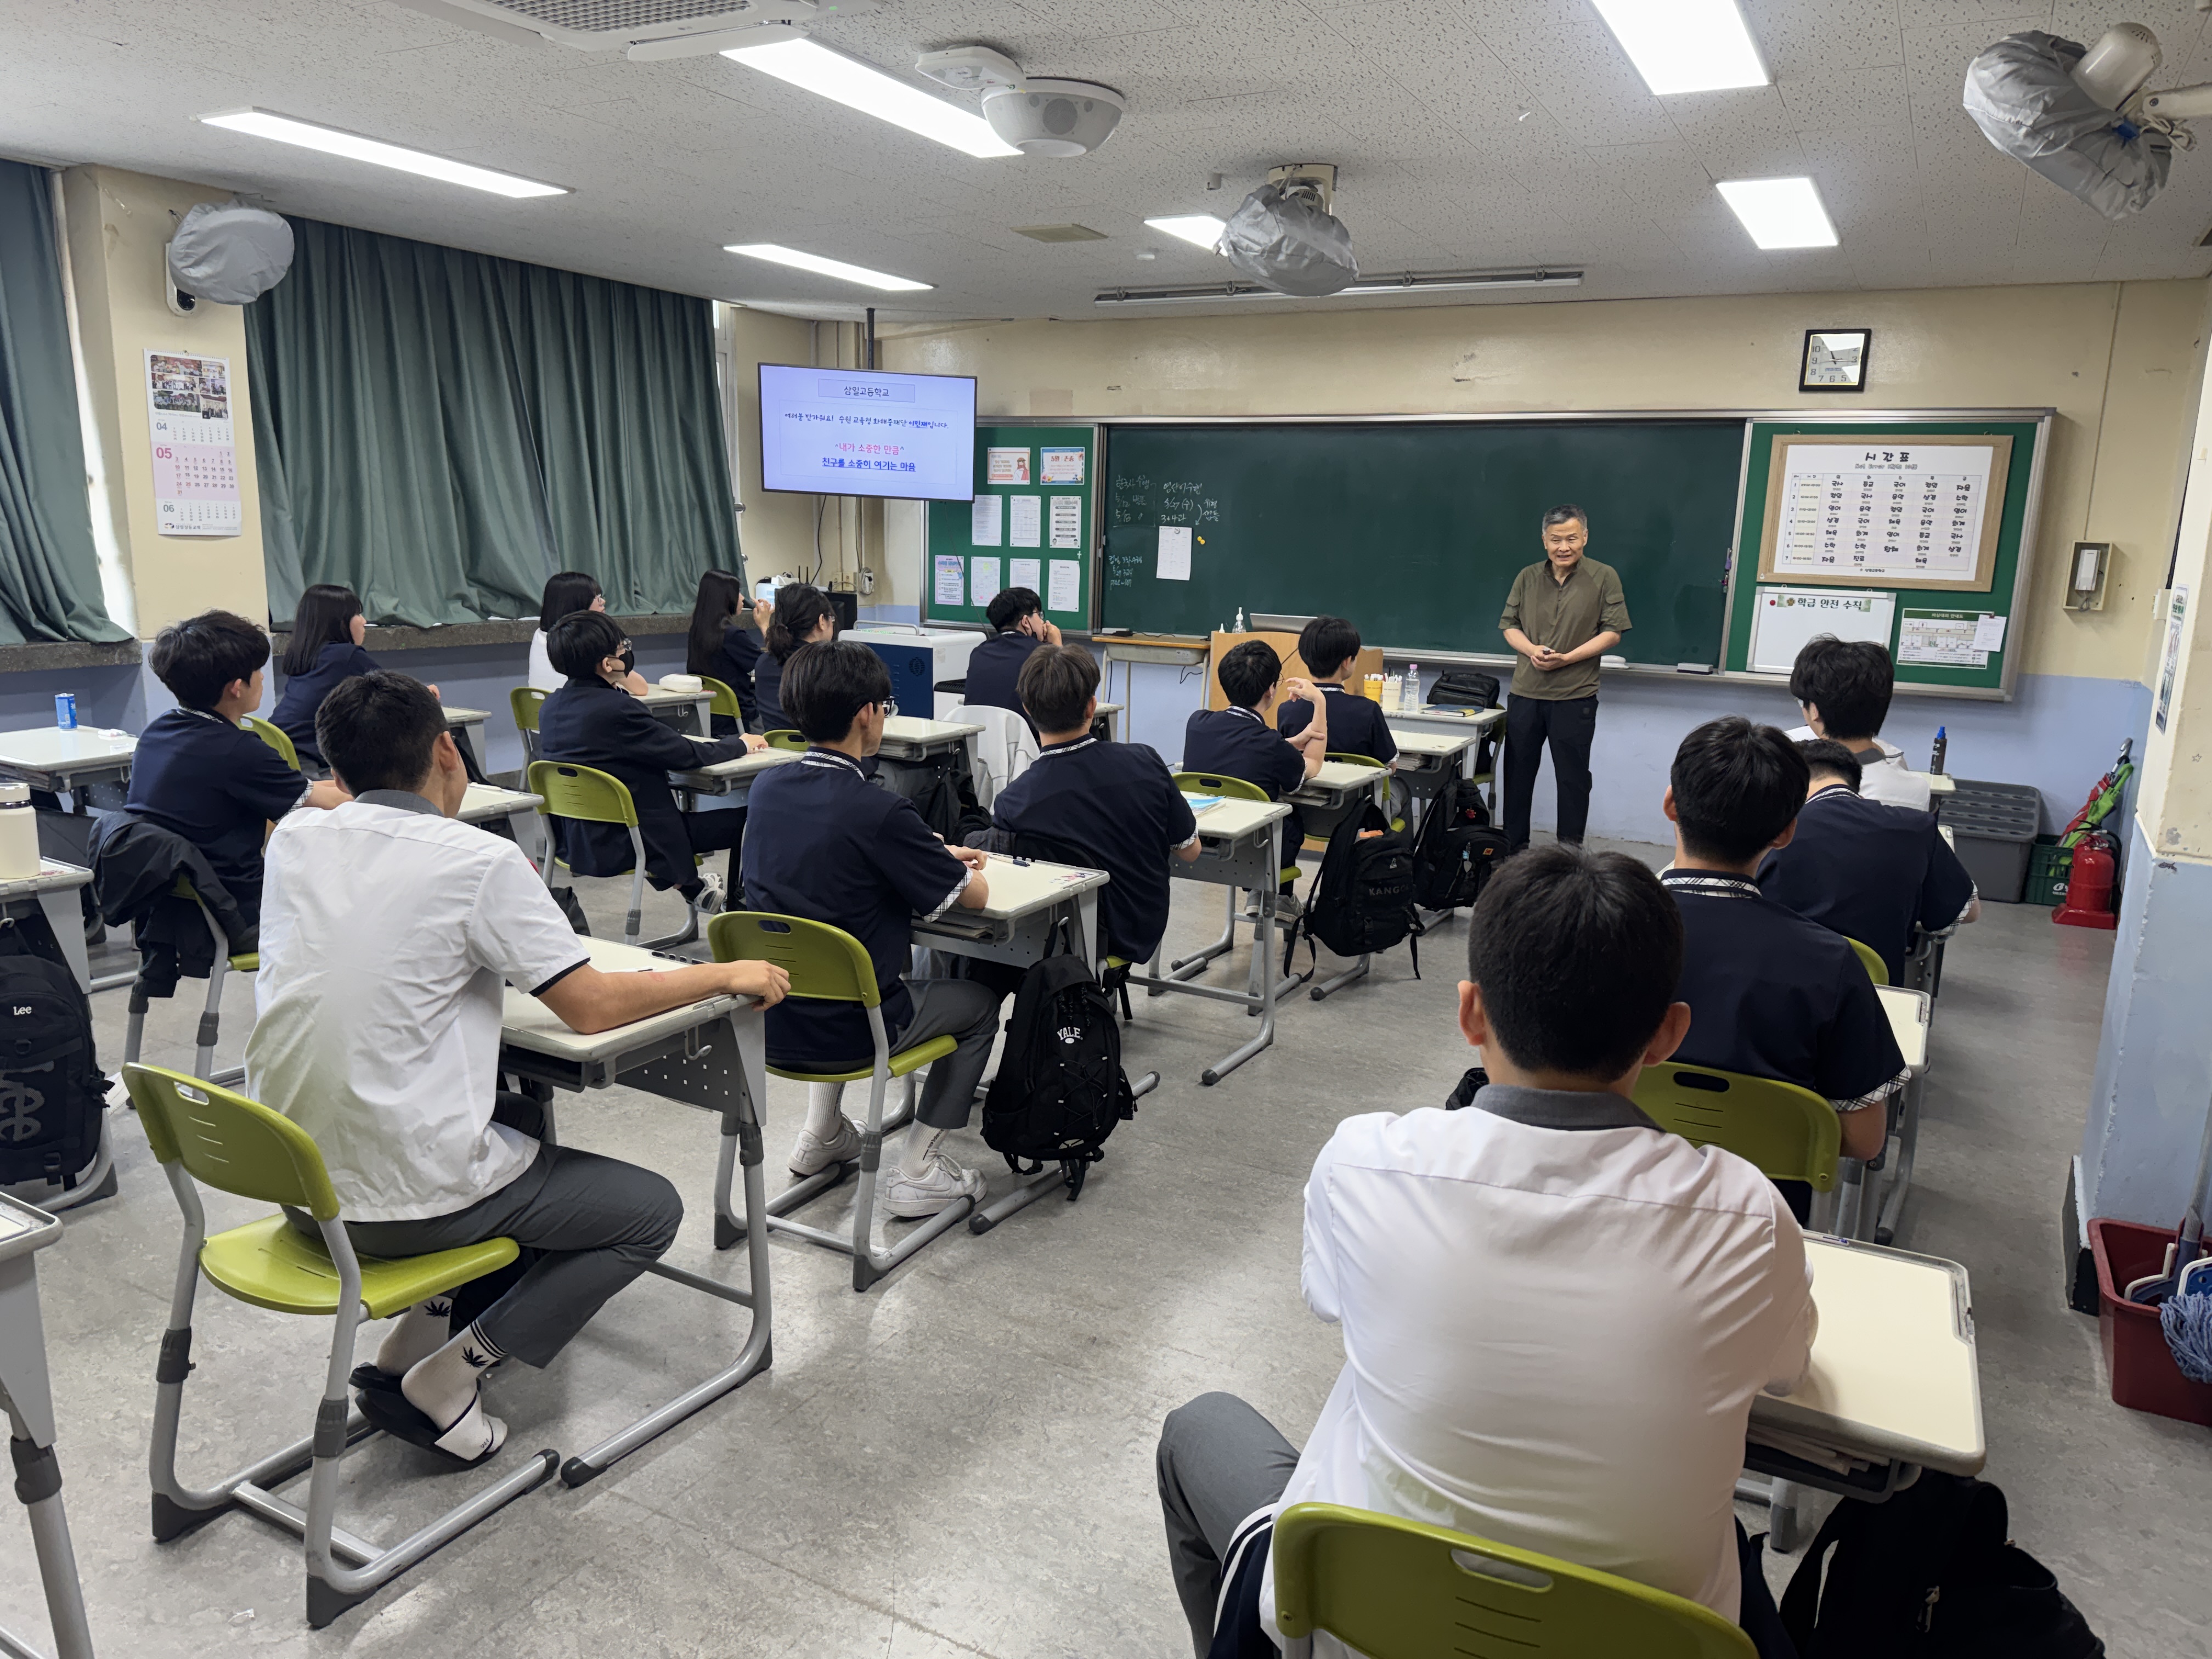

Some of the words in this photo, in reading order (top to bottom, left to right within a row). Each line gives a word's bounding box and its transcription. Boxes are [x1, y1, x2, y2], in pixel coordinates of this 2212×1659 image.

[844, 386, 889, 397] 삼일고등학교
[156, 422, 167, 430] 04
[853, 416, 871, 425] 교육청
[873, 417, 907, 427] 화해중재단
[156, 447, 172, 459] 05
[858, 444, 881, 454] 소중한
[822, 457, 845, 467] 친구를
[848, 459, 871, 469] 소중히
[874, 461, 898, 470] 여기는
[900, 462, 916, 472] 마음
[163, 504, 174, 512] 06
[1164, 496, 1180, 510] 5/27
[1182, 498, 1193, 511] (수)
[1797, 597, 1816, 607] 학급
[1820, 599, 1838, 608] 안전
[1843, 600, 1861, 610] 수칙
[13, 1006, 32, 1015] Lee
[1057, 1026, 1081, 1040] YALE
